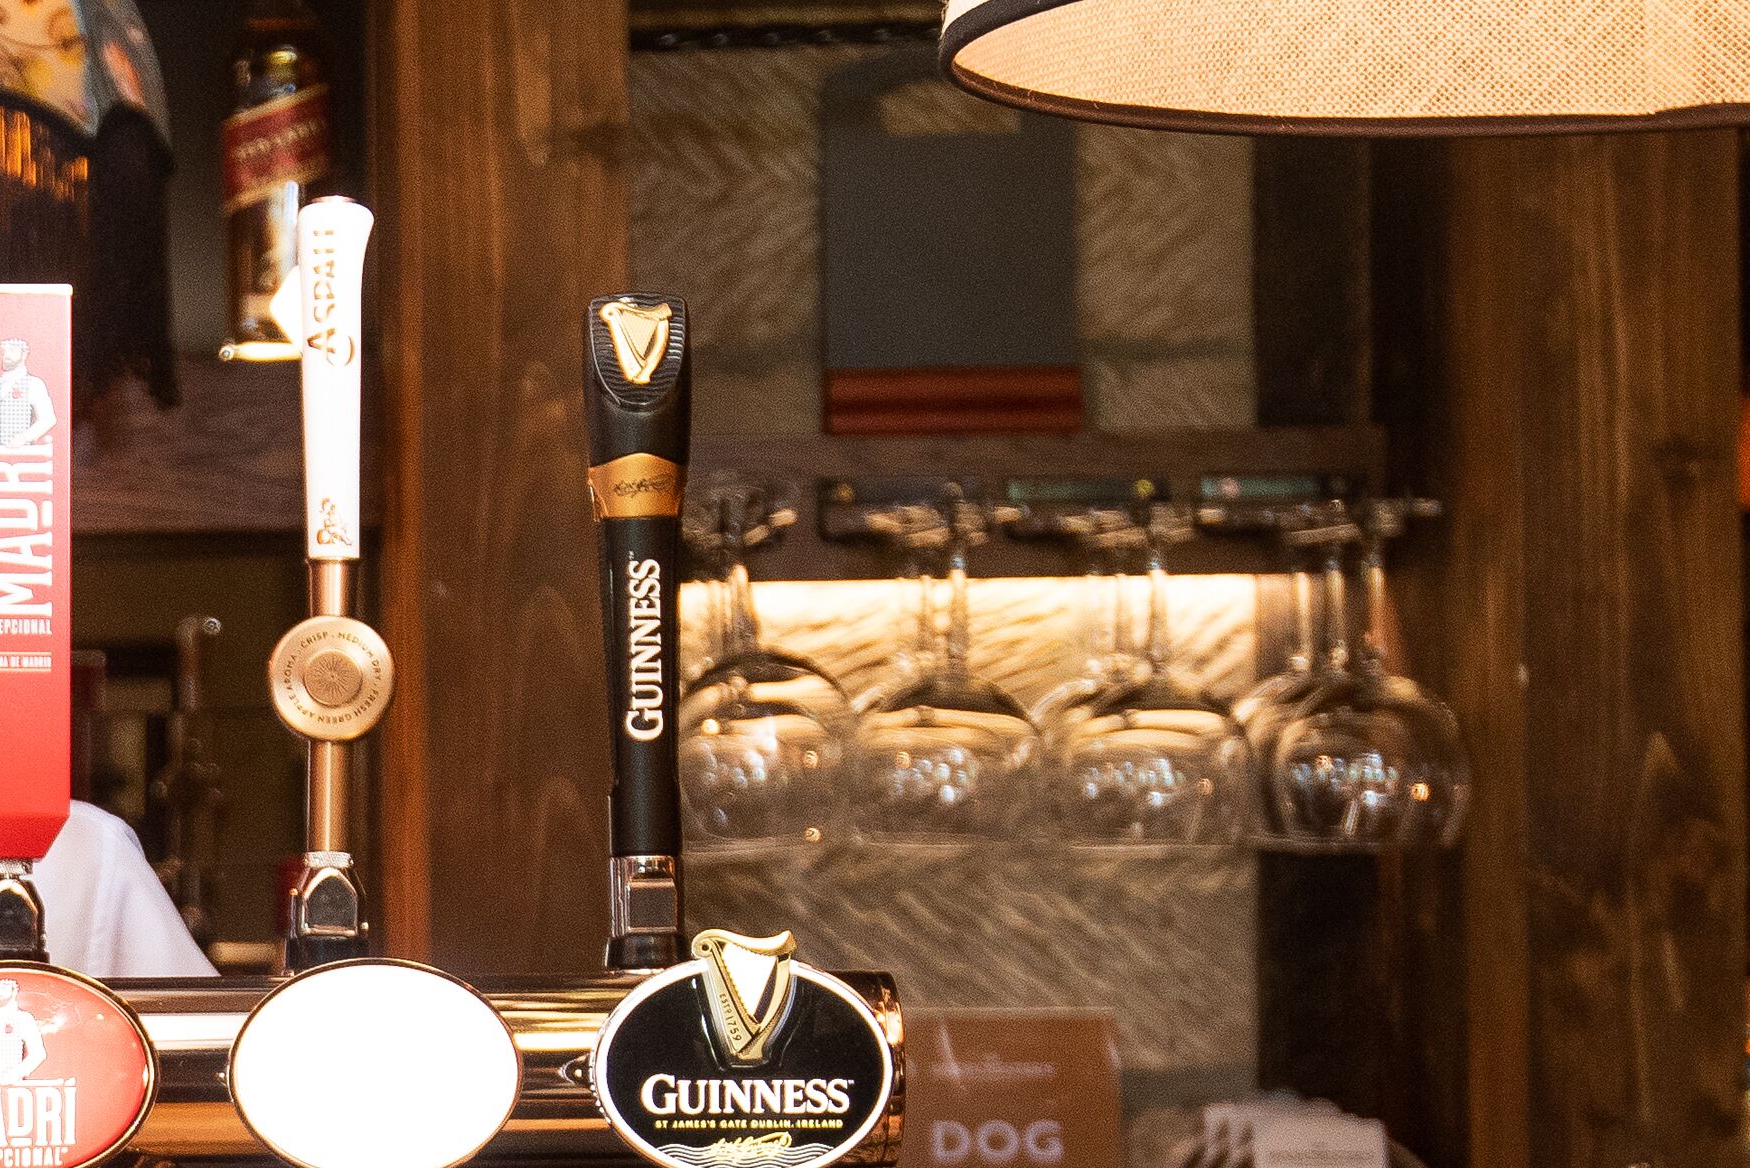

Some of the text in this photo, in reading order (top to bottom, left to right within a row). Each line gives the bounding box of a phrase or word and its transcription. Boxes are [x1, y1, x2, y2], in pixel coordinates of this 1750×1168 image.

[624, 557, 664, 744] GUINNESS
[725, 1016, 743, 1041] 1759
[640, 1073, 851, 1115] GUINNESS
[719, 1119, 748, 1129] GATE
[796, 1119, 844, 1129] IRELAND
[931, 1118, 1065, 1165] DOG
